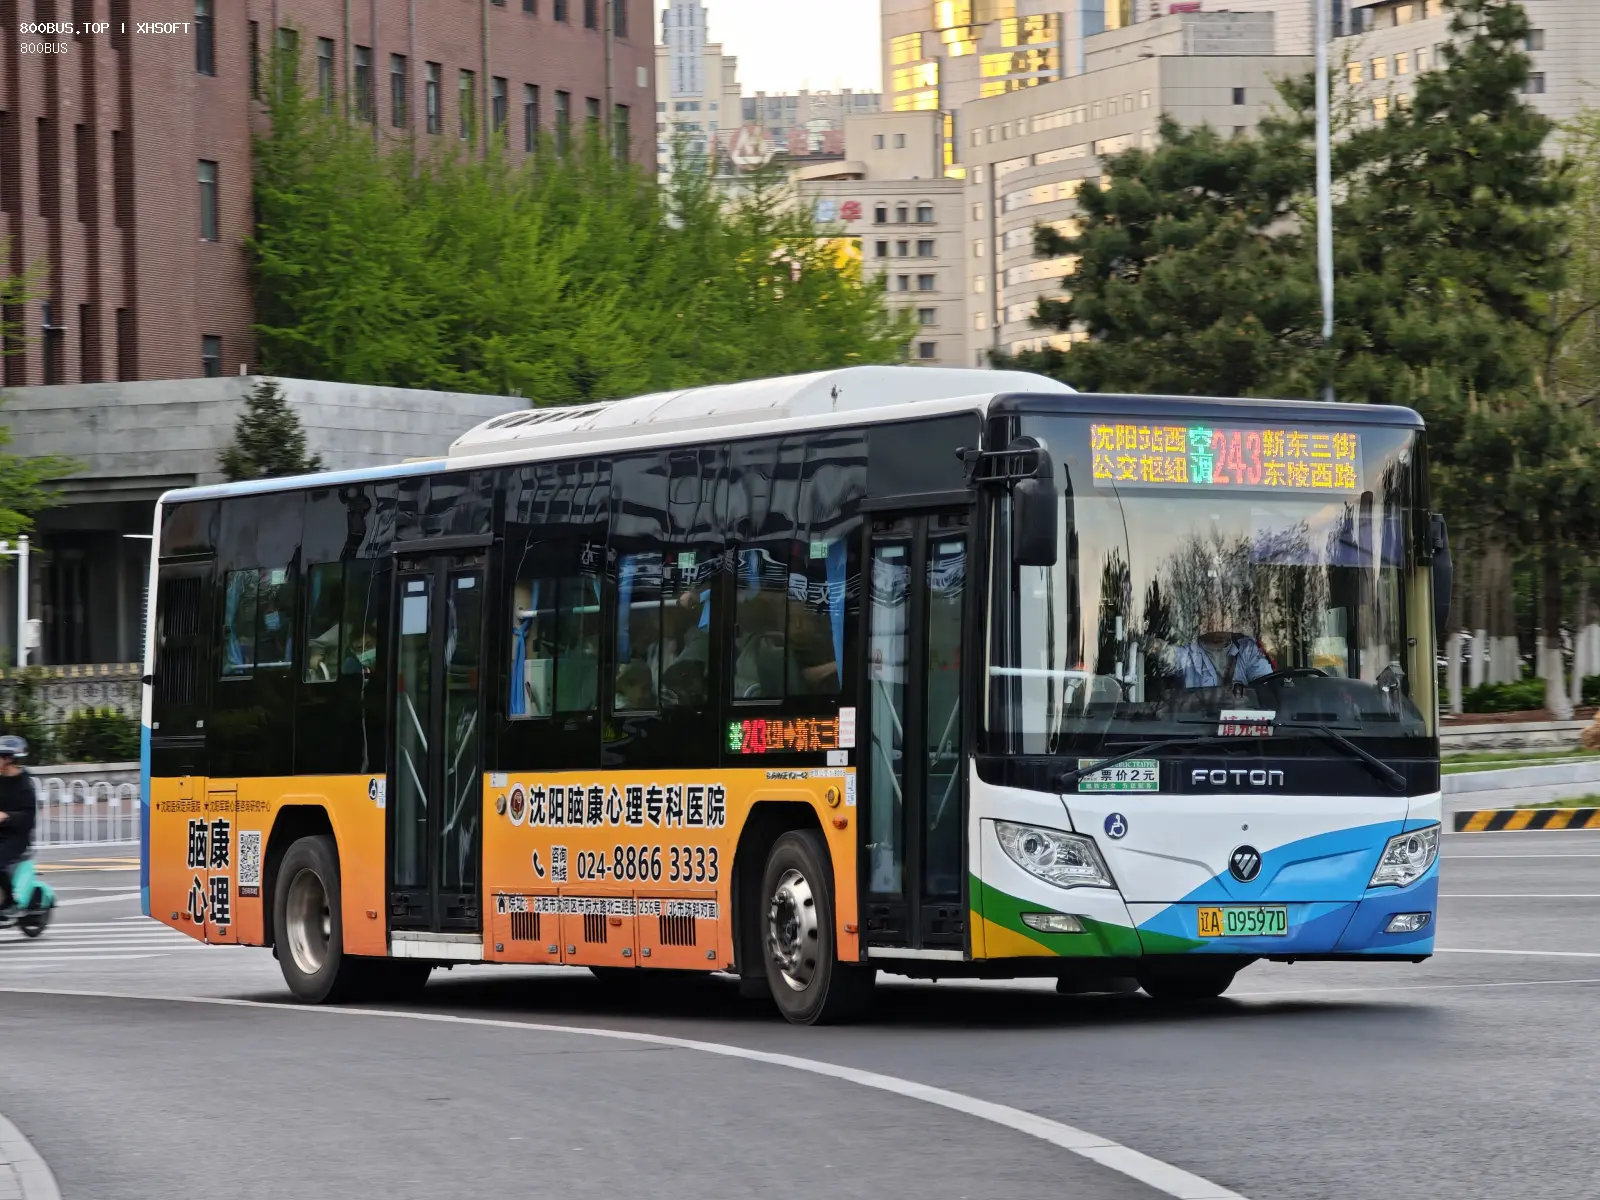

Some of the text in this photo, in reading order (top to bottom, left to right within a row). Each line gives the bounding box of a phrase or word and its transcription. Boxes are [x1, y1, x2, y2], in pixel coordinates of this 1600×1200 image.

[1091, 424, 1187, 453] 沈阳站西
[1263, 430, 1357, 460] 新东三街
[1094, 454, 1189, 483] 公交枢纽
[1189, 427, 1213, 484] 空调
[1212, 429, 1262, 484] 243
[1264, 461, 1358, 489] 东陵西路
[1101, 769, 1155, 781] 票价2元
[1191, 769, 1284, 786] FOTON
[529, 785, 726, 826] 沈阳脑康心理专科医院
[187, 819, 230, 869] 脑康
[577, 845, 719, 882] 024-8866 3333
[187, 876, 231, 924] 心理
[1200, 911, 1286, 932] 辽A 09597D
